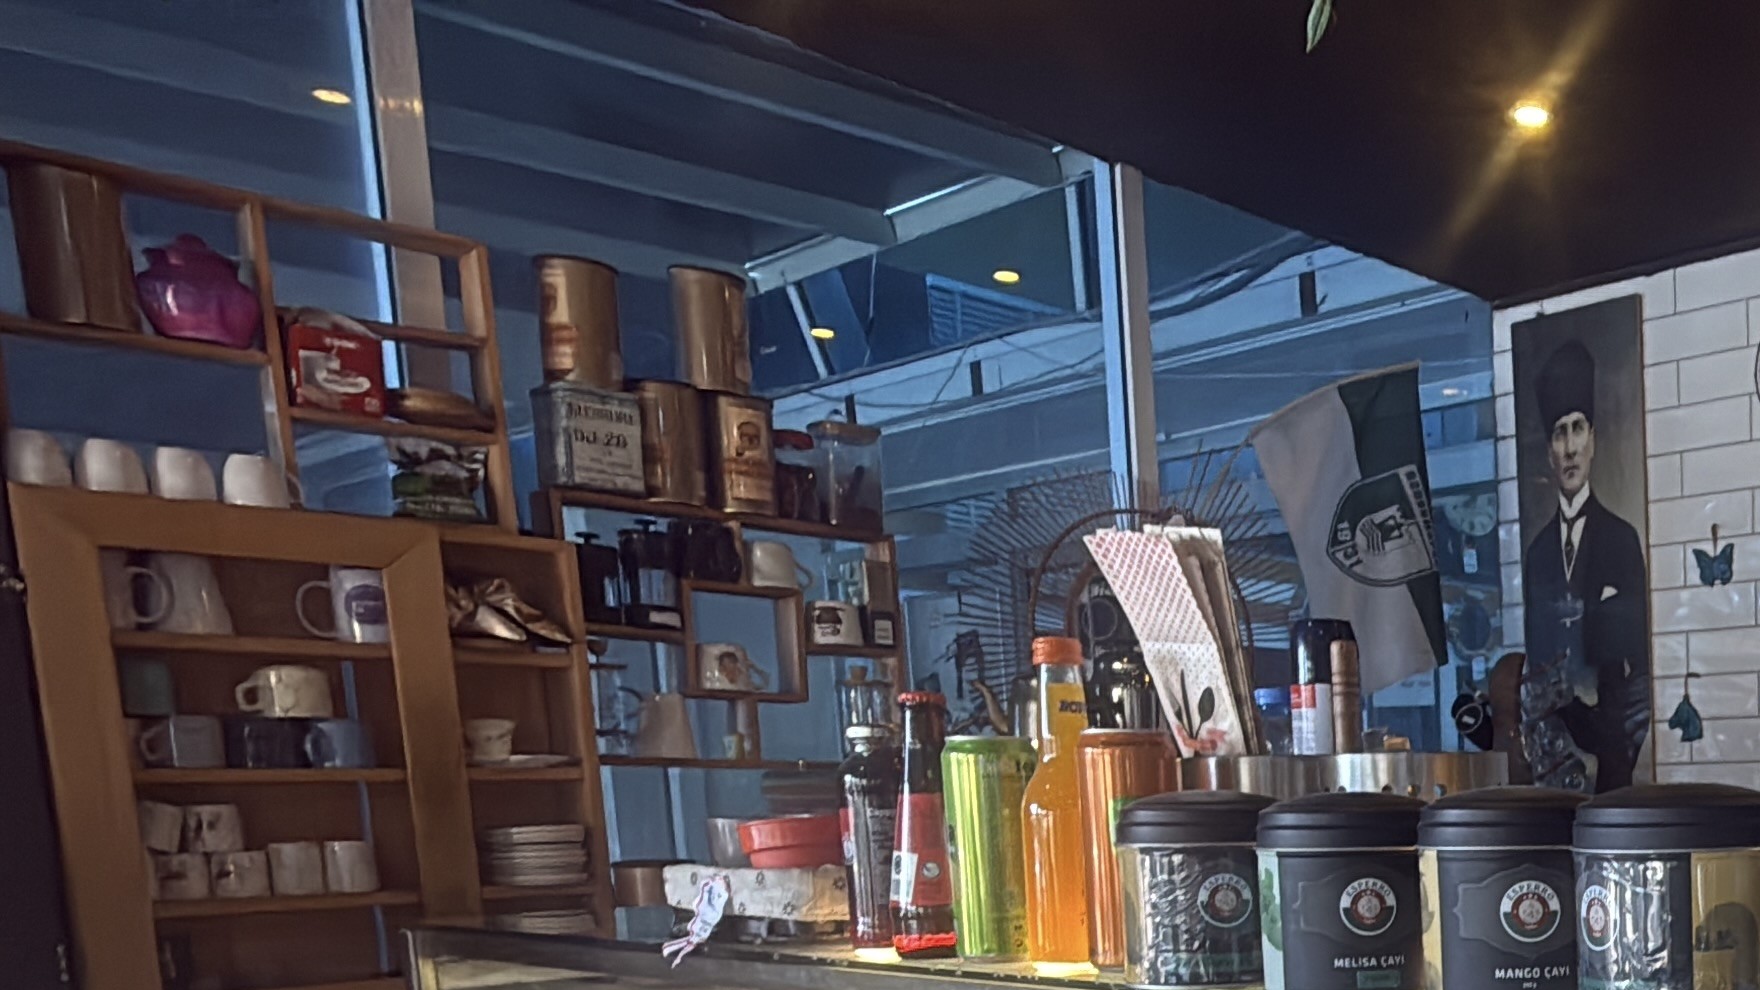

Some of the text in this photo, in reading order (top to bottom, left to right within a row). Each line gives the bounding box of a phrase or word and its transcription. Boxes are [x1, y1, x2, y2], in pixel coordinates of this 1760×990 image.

[1345, 880, 1391, 897] ESPERRO
[1506, 882, 1555, 901] ESPERRO
[1494, 967, 1541, 979] MANGO
